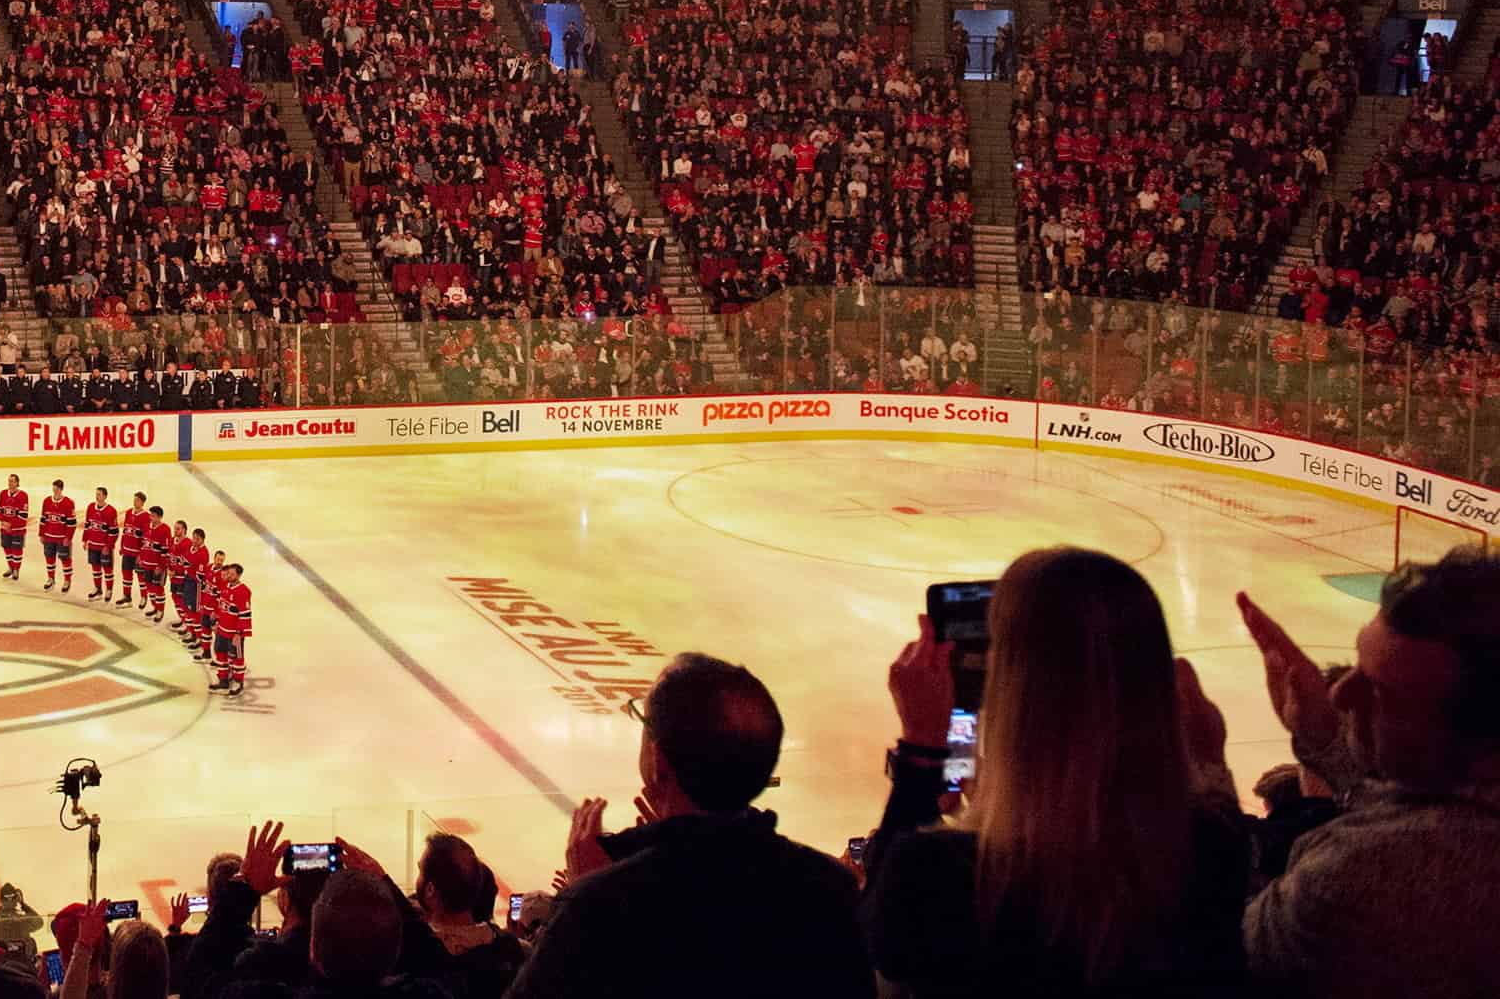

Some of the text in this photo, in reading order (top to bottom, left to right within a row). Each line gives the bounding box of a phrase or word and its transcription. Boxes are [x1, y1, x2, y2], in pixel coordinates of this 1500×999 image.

[386, 409, 521, 437] Télé Fibe Bell
[545, 402, 680, 420] ROCK THE RINK
[561, 418, 664, 433] 14 NOVEMBRE
[702, 400, 832, 427] pizza pizza
[859, 400, 1010, 425] Banque Scotia
[28, 418, 156, 452] FLAMINGO
[1159, 423, 1263, 464] Techo-Bloc
[1300, 451, 1433, 506] Télé Fibe Bell
[1446, 488, 1500, 526] Ford
[445, 576, 578, 629] MISE
[520, 631, 631, 667] AU
[581, 620, 666, 657] LNH
